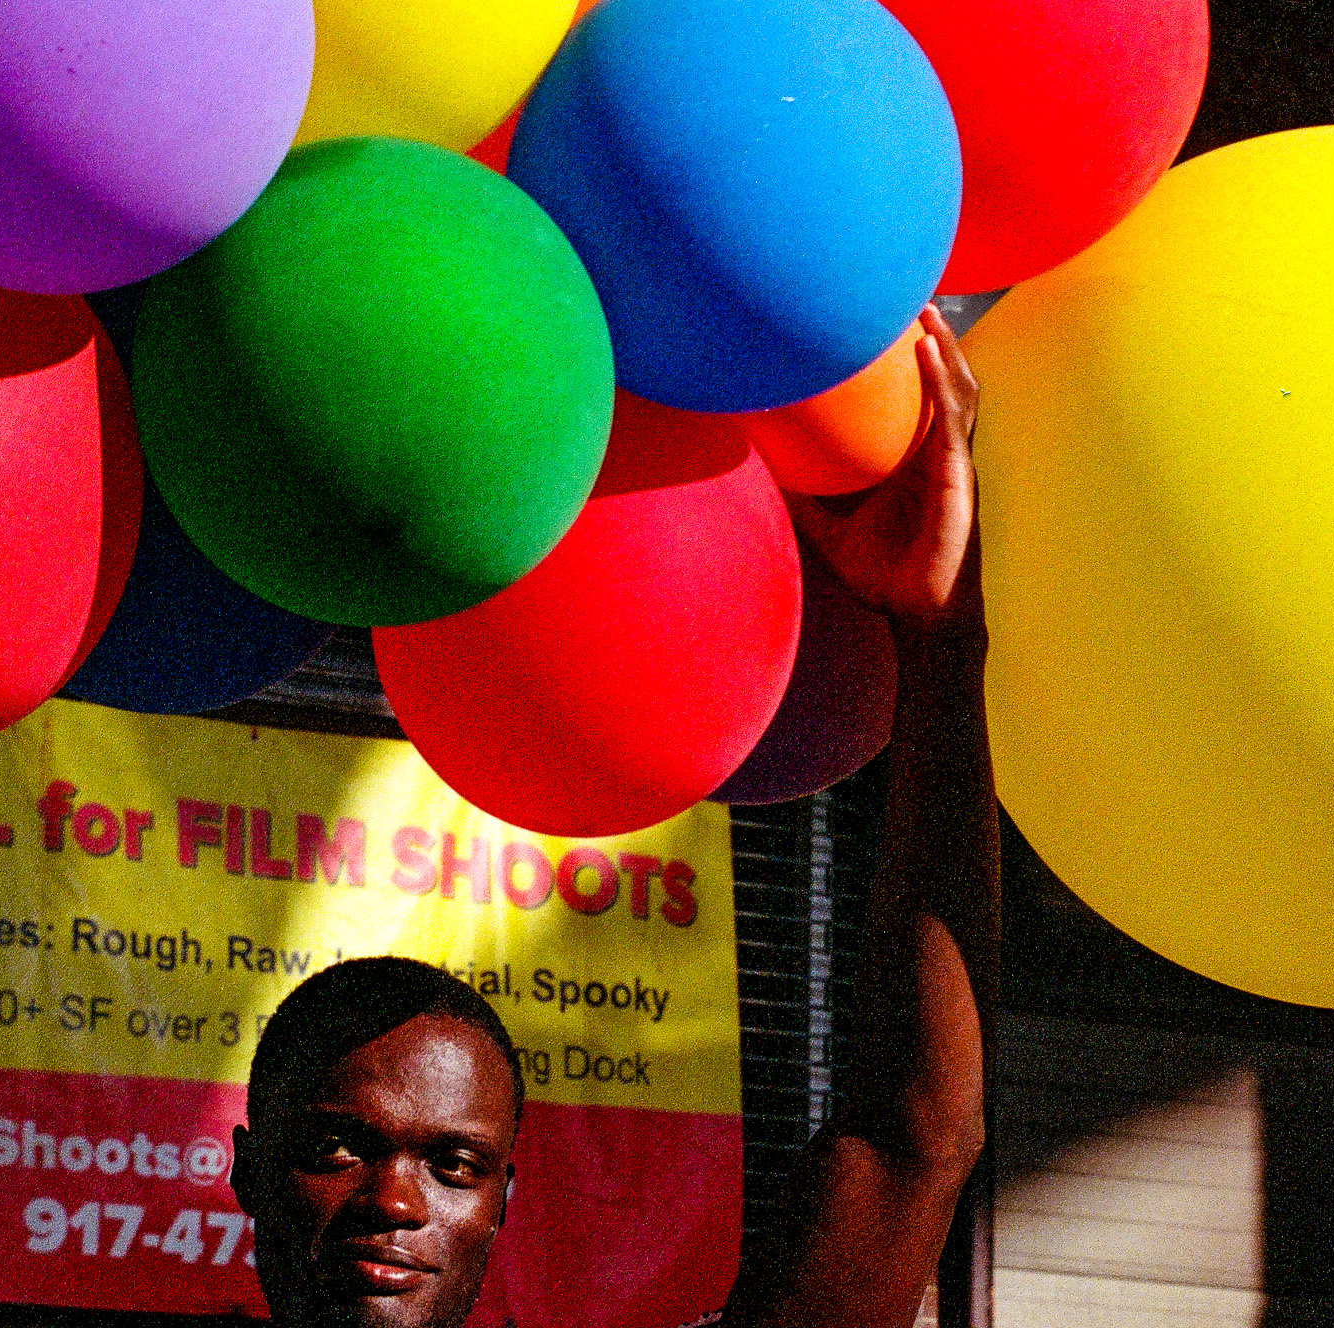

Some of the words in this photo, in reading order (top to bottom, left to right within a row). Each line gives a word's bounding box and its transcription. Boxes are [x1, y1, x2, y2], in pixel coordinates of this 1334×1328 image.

[37, 779, 155, 862] for
[175, 796, 367, 888] FILM
[391, 825, 699, 928] SHOOTS
[71, 918, 214, 974] Rough,
[227, 934, 312, 976] Raw
[531, 967, 670, 1023] Spooky
[59, 992, 114, 1032] SF
[127, 1010, 209, 1044] over
[217, 1010, 242, 1048] 3
[564, 1045, 652, 1087] Dock
